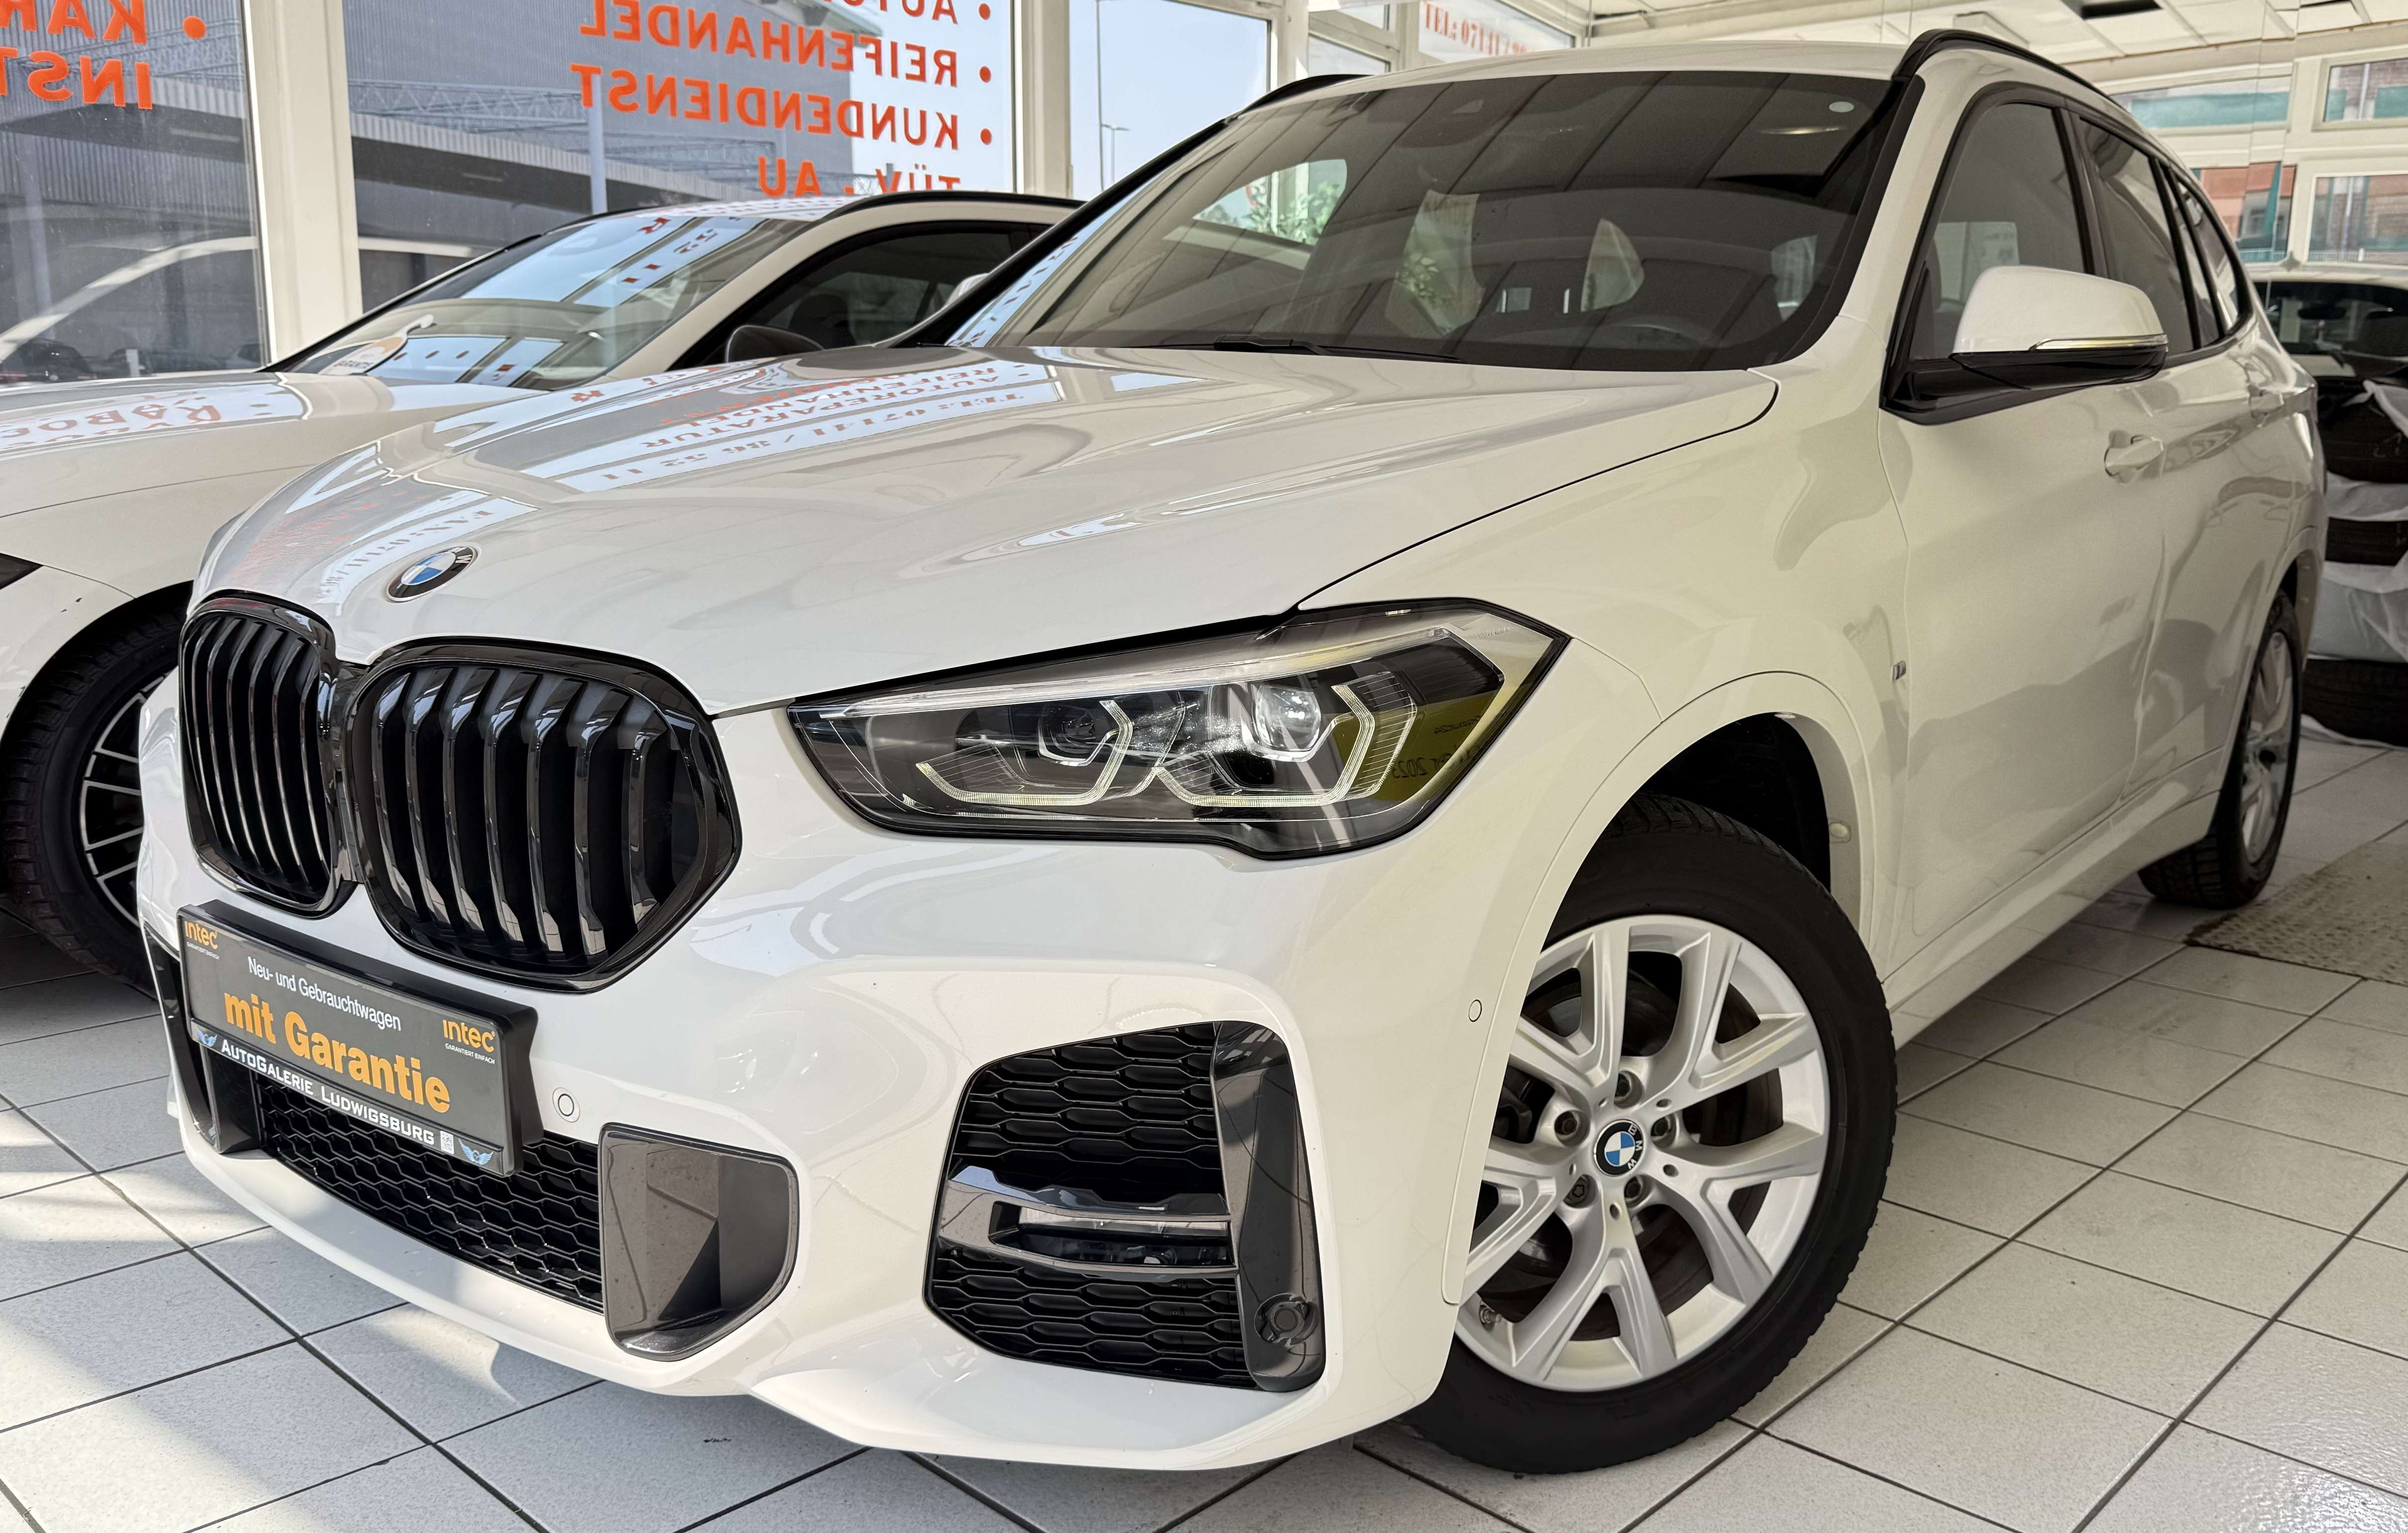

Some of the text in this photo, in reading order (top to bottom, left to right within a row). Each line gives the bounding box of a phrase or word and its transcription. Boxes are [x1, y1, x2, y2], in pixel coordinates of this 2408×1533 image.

[248, 956, 402, 1031] Neu- und Gebrauchtwagen
[224, 993, 450, 1114] mit Garantie
[321, 1085, 435, 1145] LUDWIGSBURG
[1627, 1123, 1644, 1170] BMW
